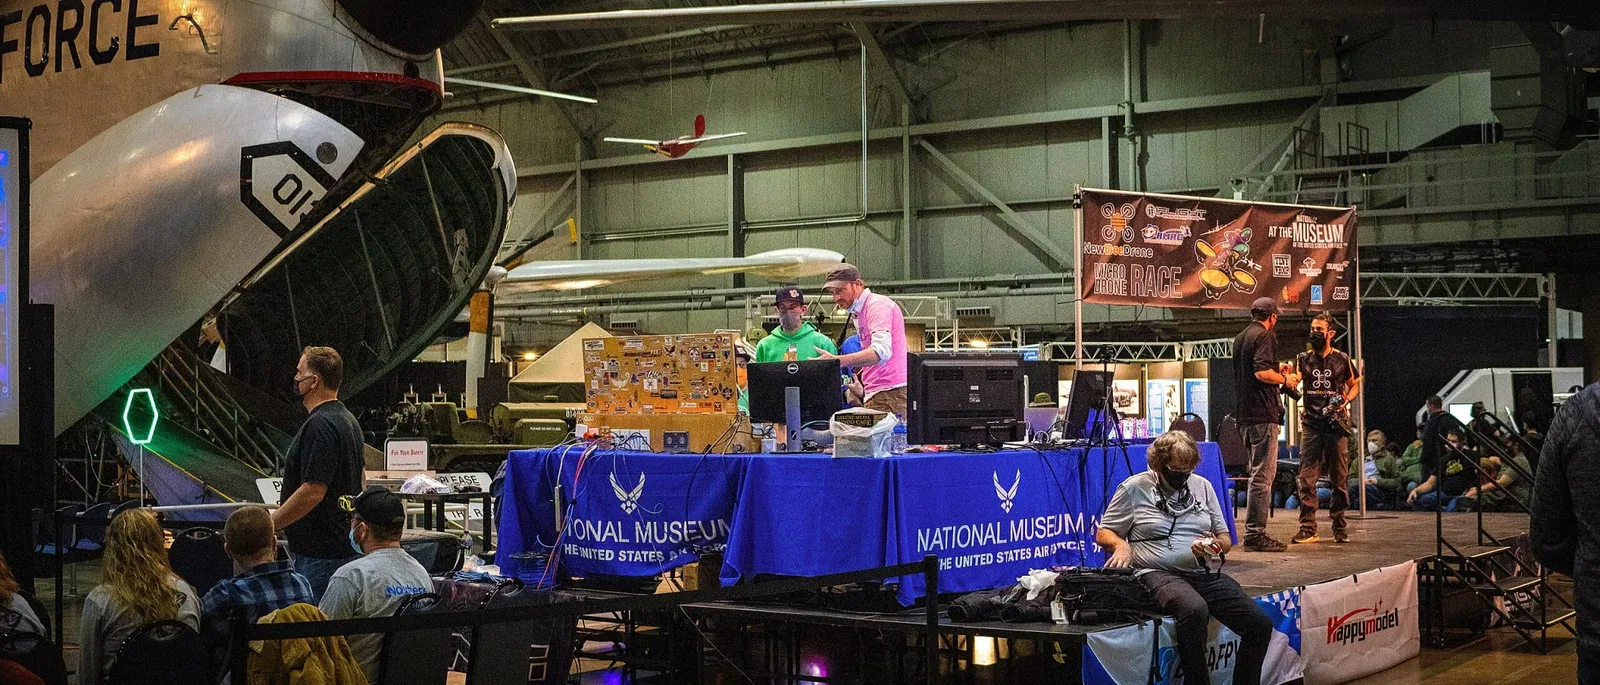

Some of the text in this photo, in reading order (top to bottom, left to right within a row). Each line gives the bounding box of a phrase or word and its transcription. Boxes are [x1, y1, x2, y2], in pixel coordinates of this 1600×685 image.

[0, 0, 160, 84] FORCE
[1268, 222, 1344, 243] AT THE MUSEUM
[1083, 241, 1153, 258] NewBeeDrone
[1094, 262, 1126, 280] MICRO
[1130, 263, 1182, 298] RACE
[1094, 278, 1127, 296] DRONE
[568, 518, 630, 543] IONAL
[917, 522, 1007, 553] NATIONAL
[1010, 512, 1085, 543] MUSEUM
[564, 543, 579, 556] HE
[618, 550, 665, 562] STATES
[938, 557, 952, 571] HE
[954, 552, 994, 569] UNITED
[996, 547, 1032, 563] STATES
[1034, 545, 1049, 558] AIR
[1327, 607, 1399, 646] Happymodel
